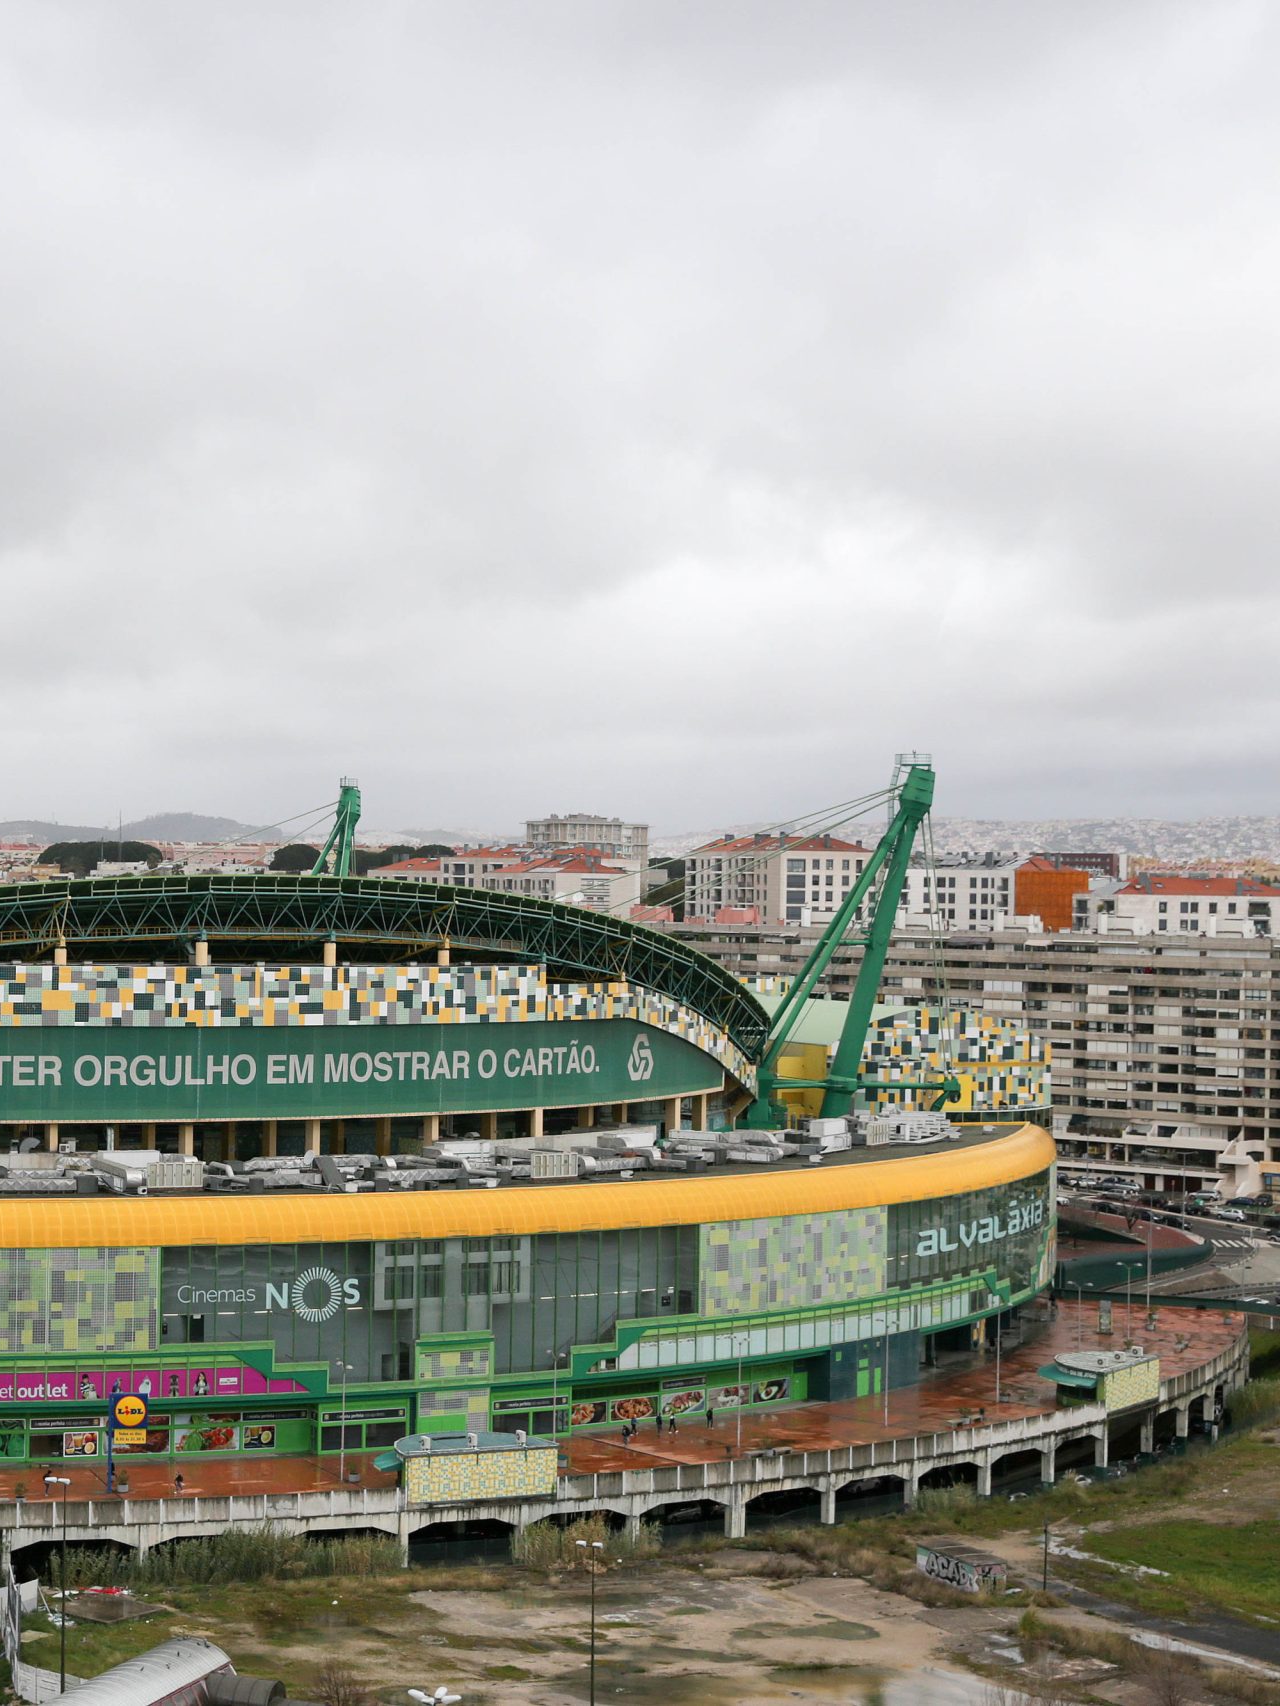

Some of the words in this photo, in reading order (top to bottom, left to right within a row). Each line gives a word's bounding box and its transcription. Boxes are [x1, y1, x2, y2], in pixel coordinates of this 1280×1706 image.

[73, 1053, 257, 1088] ORGULHO
[266, 1053, 314, 1085] EM
[323, 1049, 471, 1083] MOSTRAR
[478, 1048, 498, 1079] O
[503, 1038, 600, 1079] CARTÃO.
[177, 1284, 256, 1304] Cinemas
[17, 1383, 68, 1399] outlet
